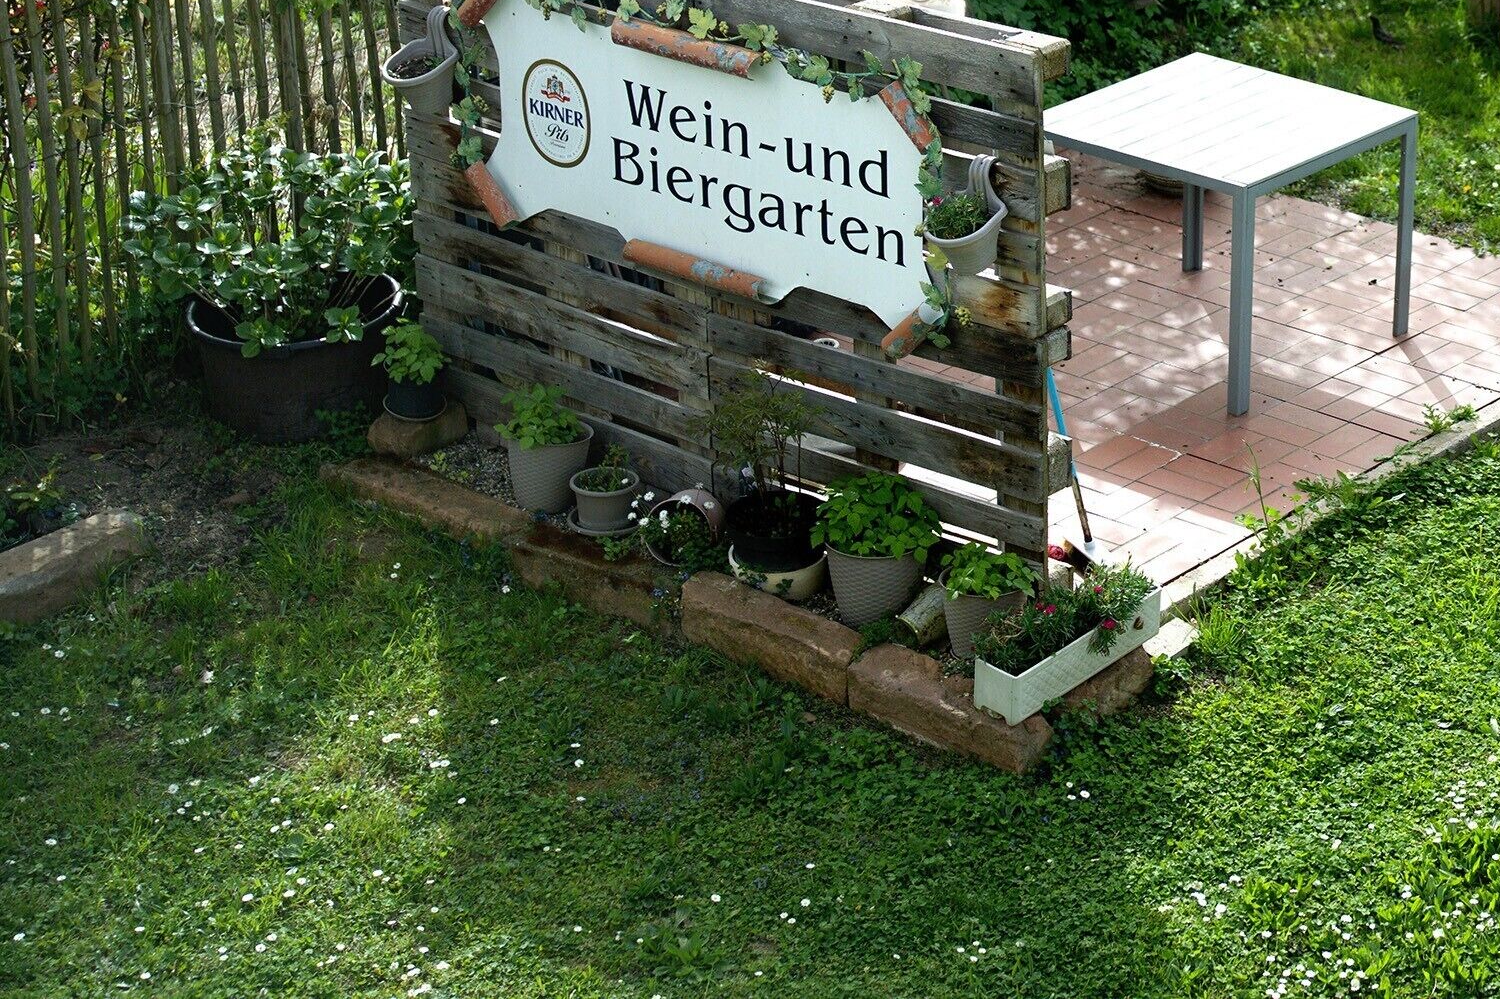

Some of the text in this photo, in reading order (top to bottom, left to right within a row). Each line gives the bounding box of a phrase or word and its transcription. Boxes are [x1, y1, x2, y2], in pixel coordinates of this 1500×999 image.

[528, 97, 586, 130] KIRNER
[544, 122, 570, 143] Pils
[622, 78, 890, 199] Wein-und
[610, 136, 907, 268] Biergarten
